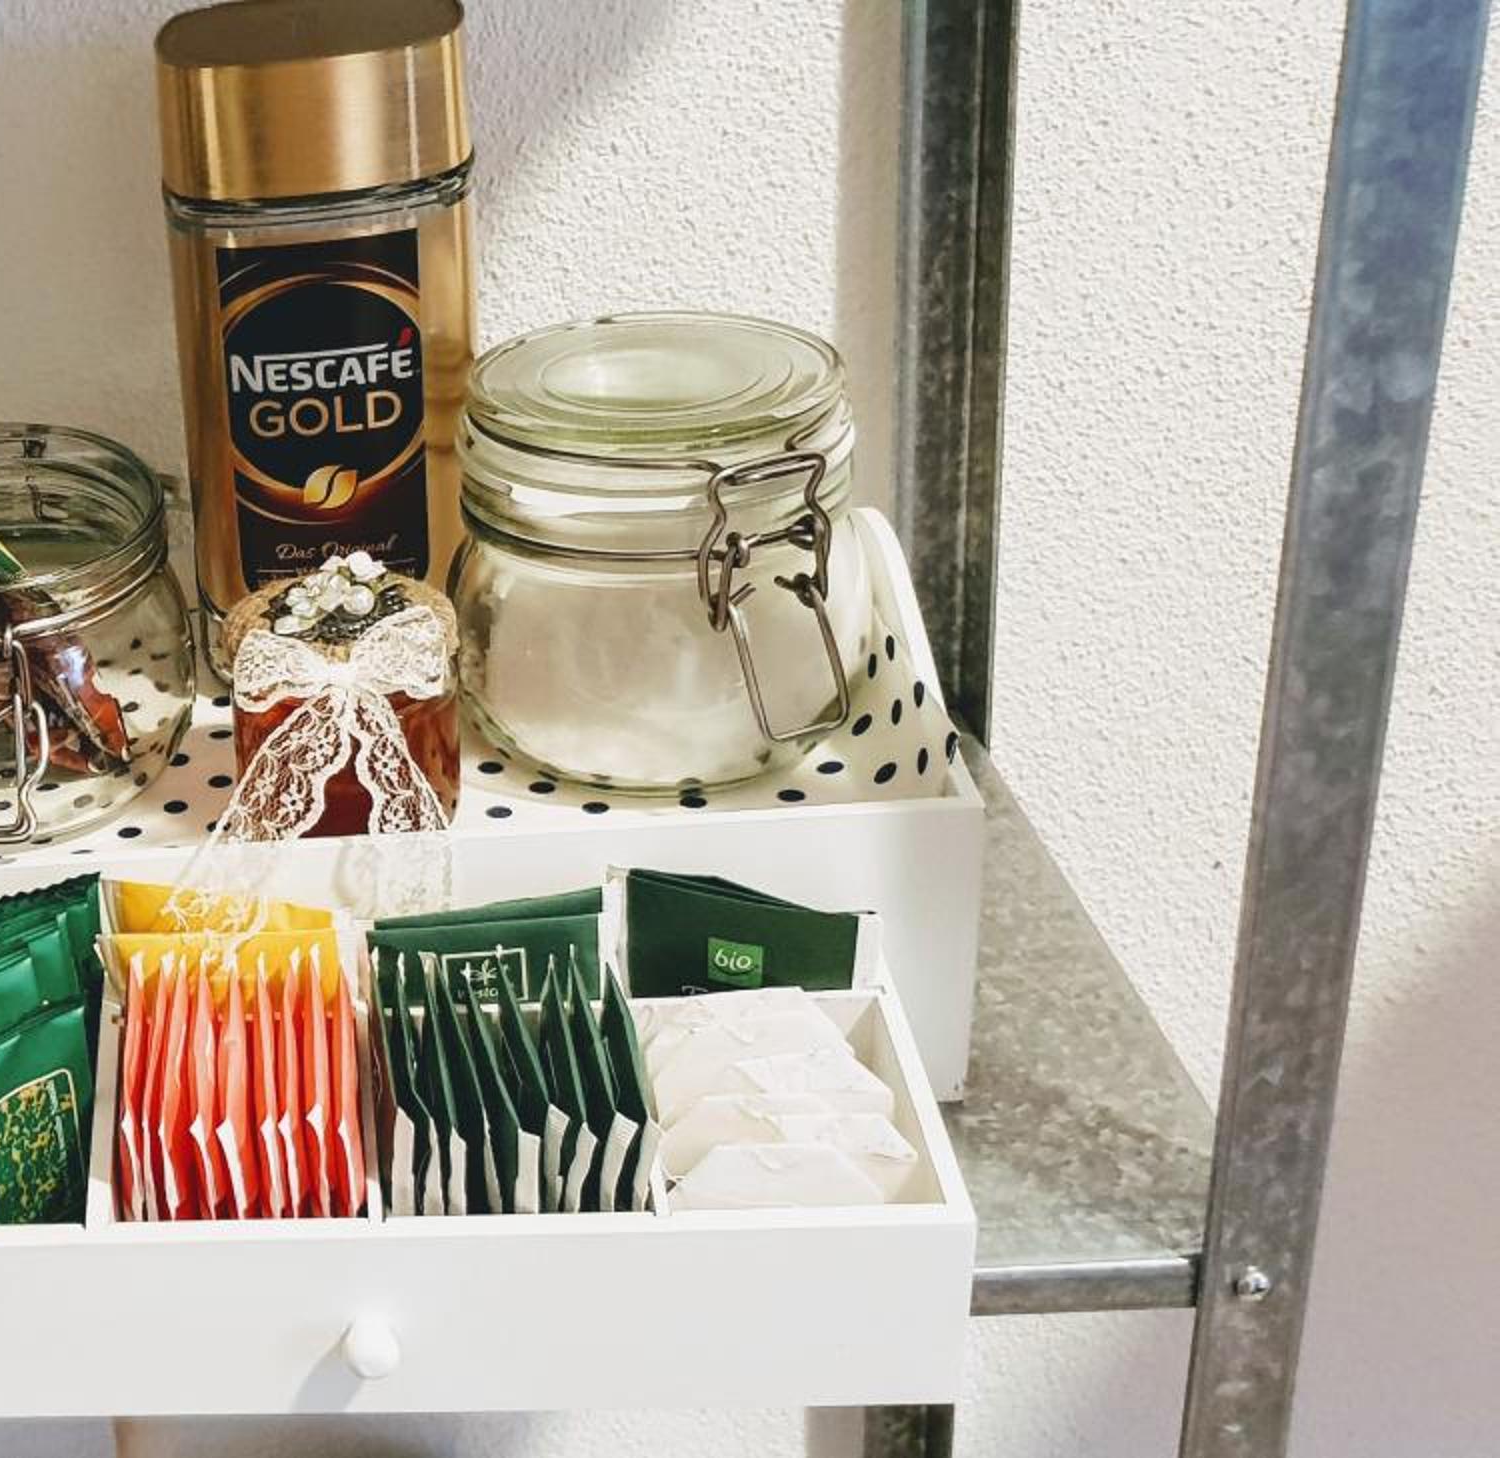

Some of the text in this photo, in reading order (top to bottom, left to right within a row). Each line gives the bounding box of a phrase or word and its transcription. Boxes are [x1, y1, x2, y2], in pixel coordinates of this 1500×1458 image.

[230, 326, 414, 393] NESCAFÉ
[250, 389, 402, 438] GOLD
[275, 542, 316, 560] Das
[713, 948, 753, 972] bio
